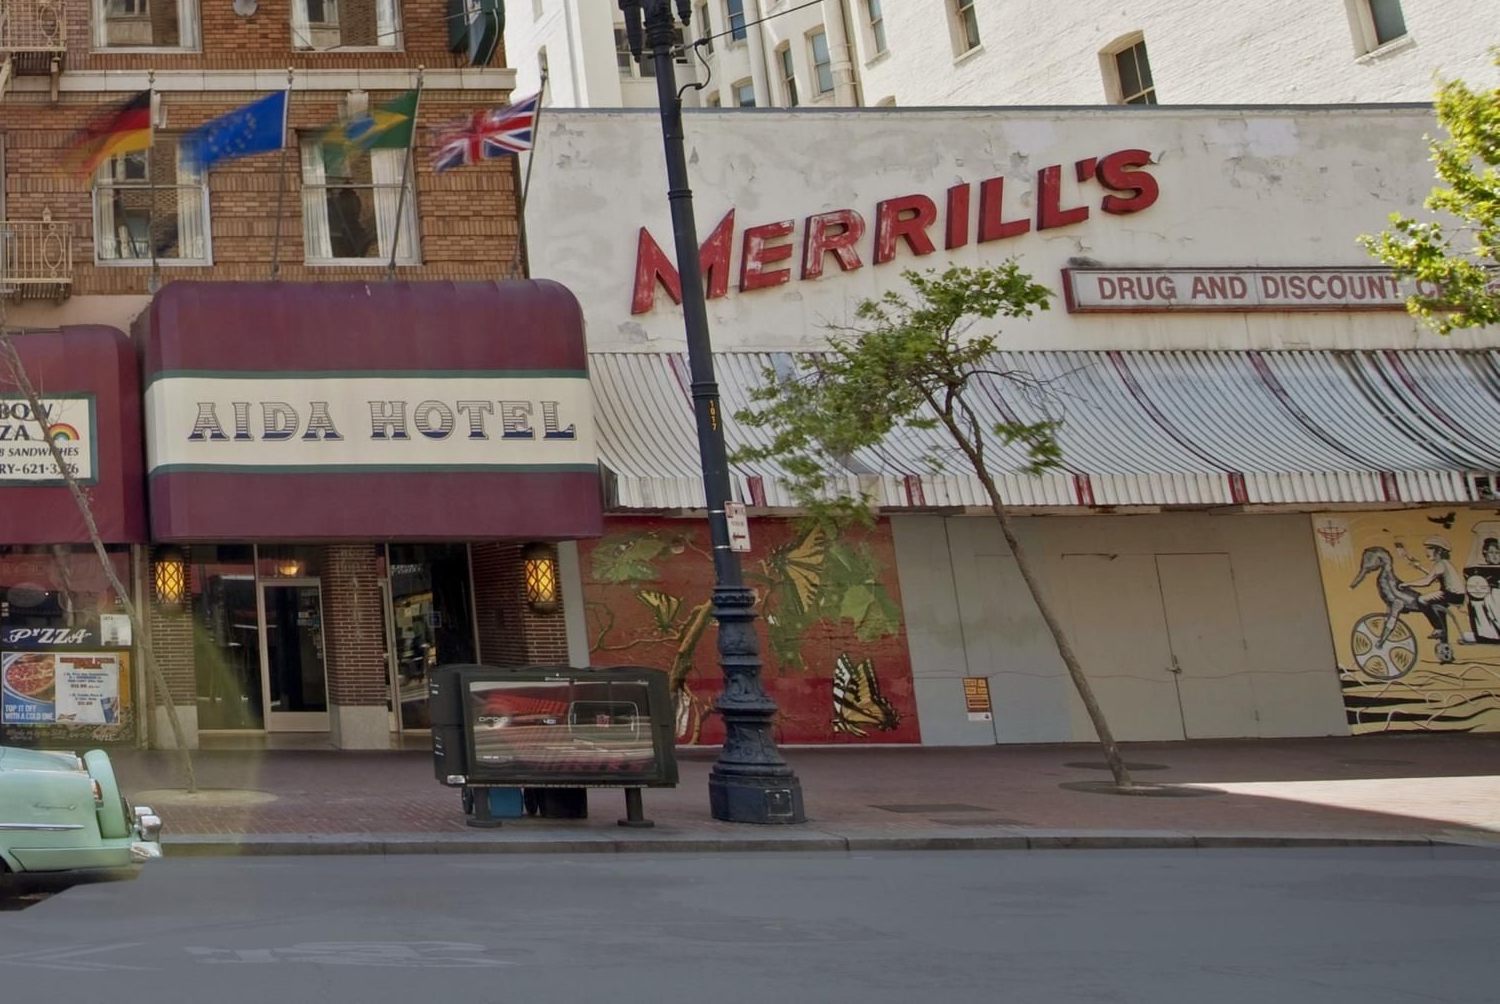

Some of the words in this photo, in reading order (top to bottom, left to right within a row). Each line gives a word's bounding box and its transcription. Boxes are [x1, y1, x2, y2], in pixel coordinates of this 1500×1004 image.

[630, 148, 1160, 316] MERRILL'S
[1097, 275, 1177, 300] DRUG
[1190, 275, 1248, 300] AND
[1261, 275, 1400, 300] DISCOUNT
[187, 401, 345, 441] AIDA
[368, 400, 578, 441] HOTEL
[7, 447, 79, 457] SANDWIHES
[5, 704, 17, 713] TOP
